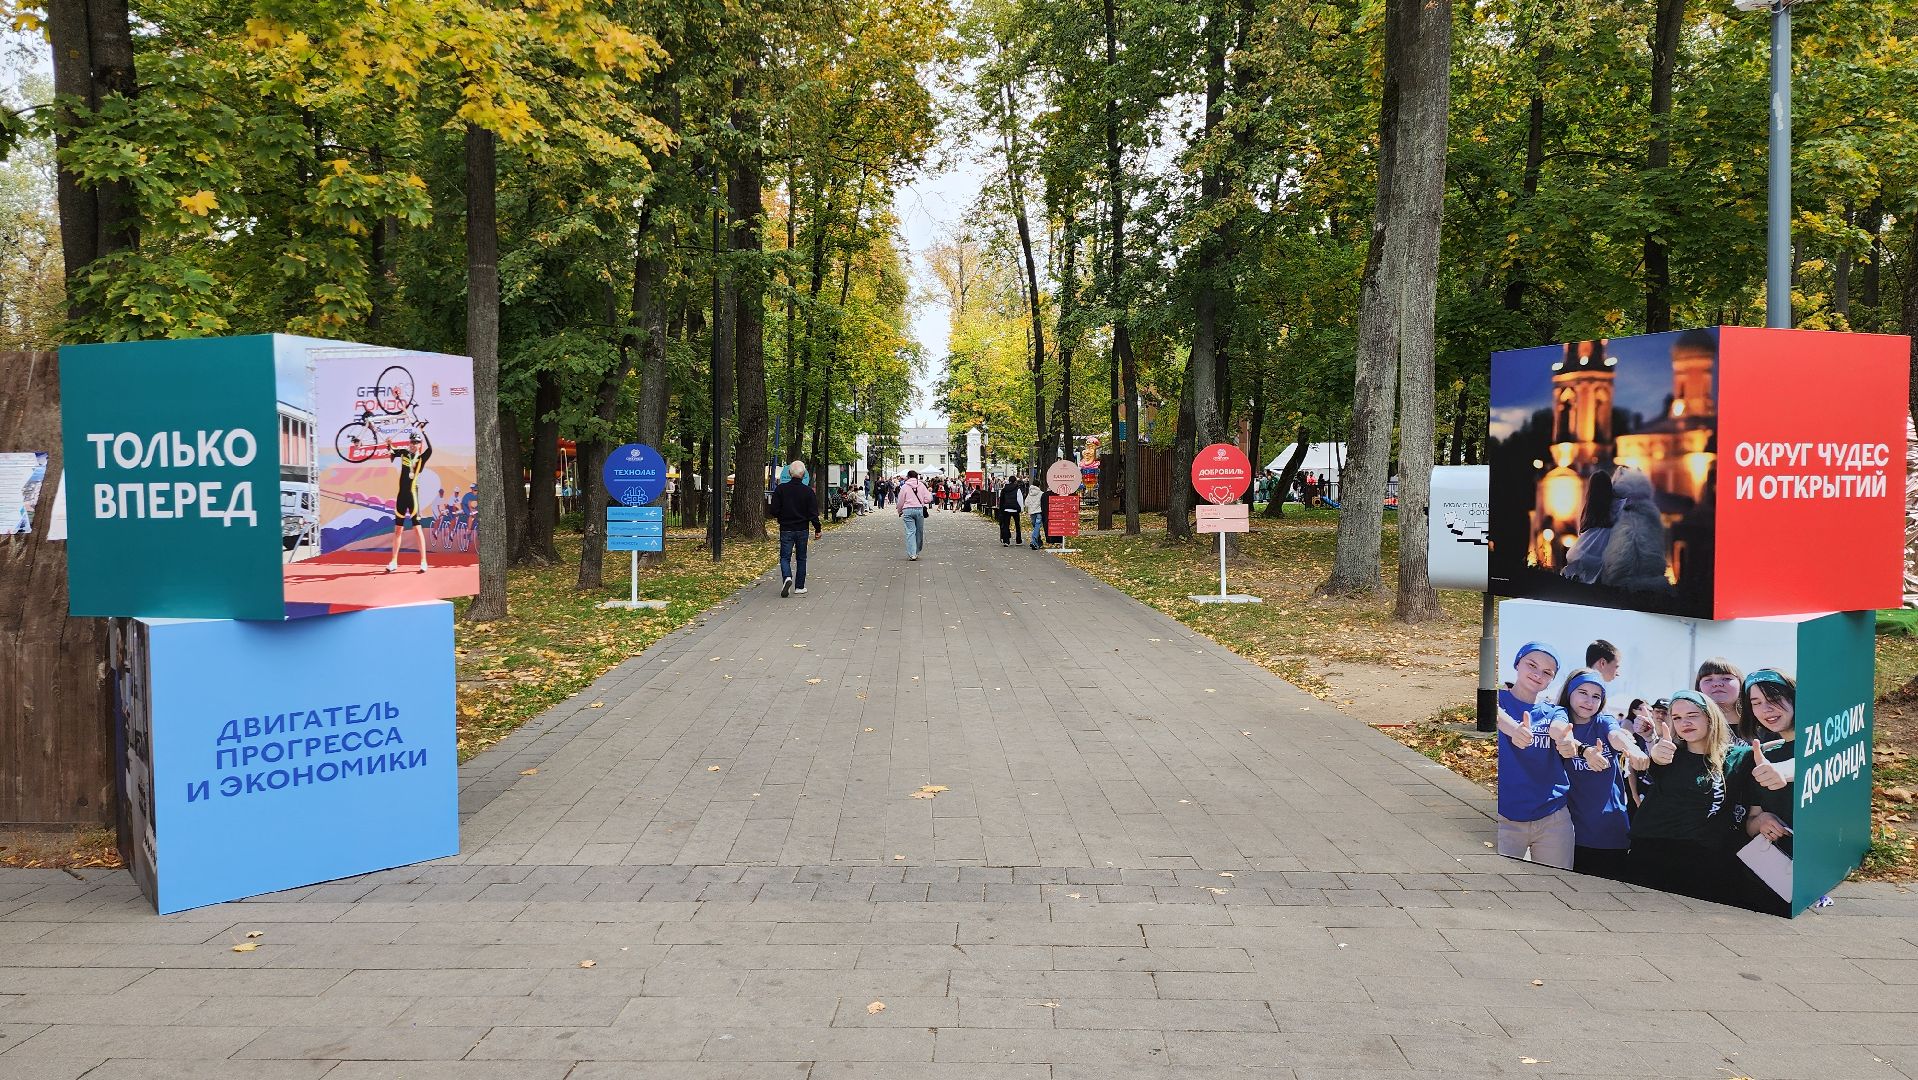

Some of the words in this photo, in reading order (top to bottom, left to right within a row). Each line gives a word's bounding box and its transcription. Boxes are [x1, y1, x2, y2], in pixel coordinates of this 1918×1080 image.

[87, 428, 257, 469] ТОЛЬКО
[1735, 442, 1813, 467] ОКРУГ
[1818, 443, 1889, 471] ЧУДЕС
[94, 481, 257, 527] ВПЕРЕД
[1736, 475, 1753, 499] И
[1759, 470, 1887, 499] ОТКРЫТИЙ
[216, 701, 400, 746] ДВИГАТЕЛЬ
[1824, 703, 1865, 747] СВОИХ
[216, 726, 403, 769] ПРОГРЕССА
[187, 780, 210, 802] И
[220, 748, 427, 797] ЭКОНОМИКИ
[1801, 762, 1823, 808] ДО
[1824, 740, 1866, 781] КОНЦА
